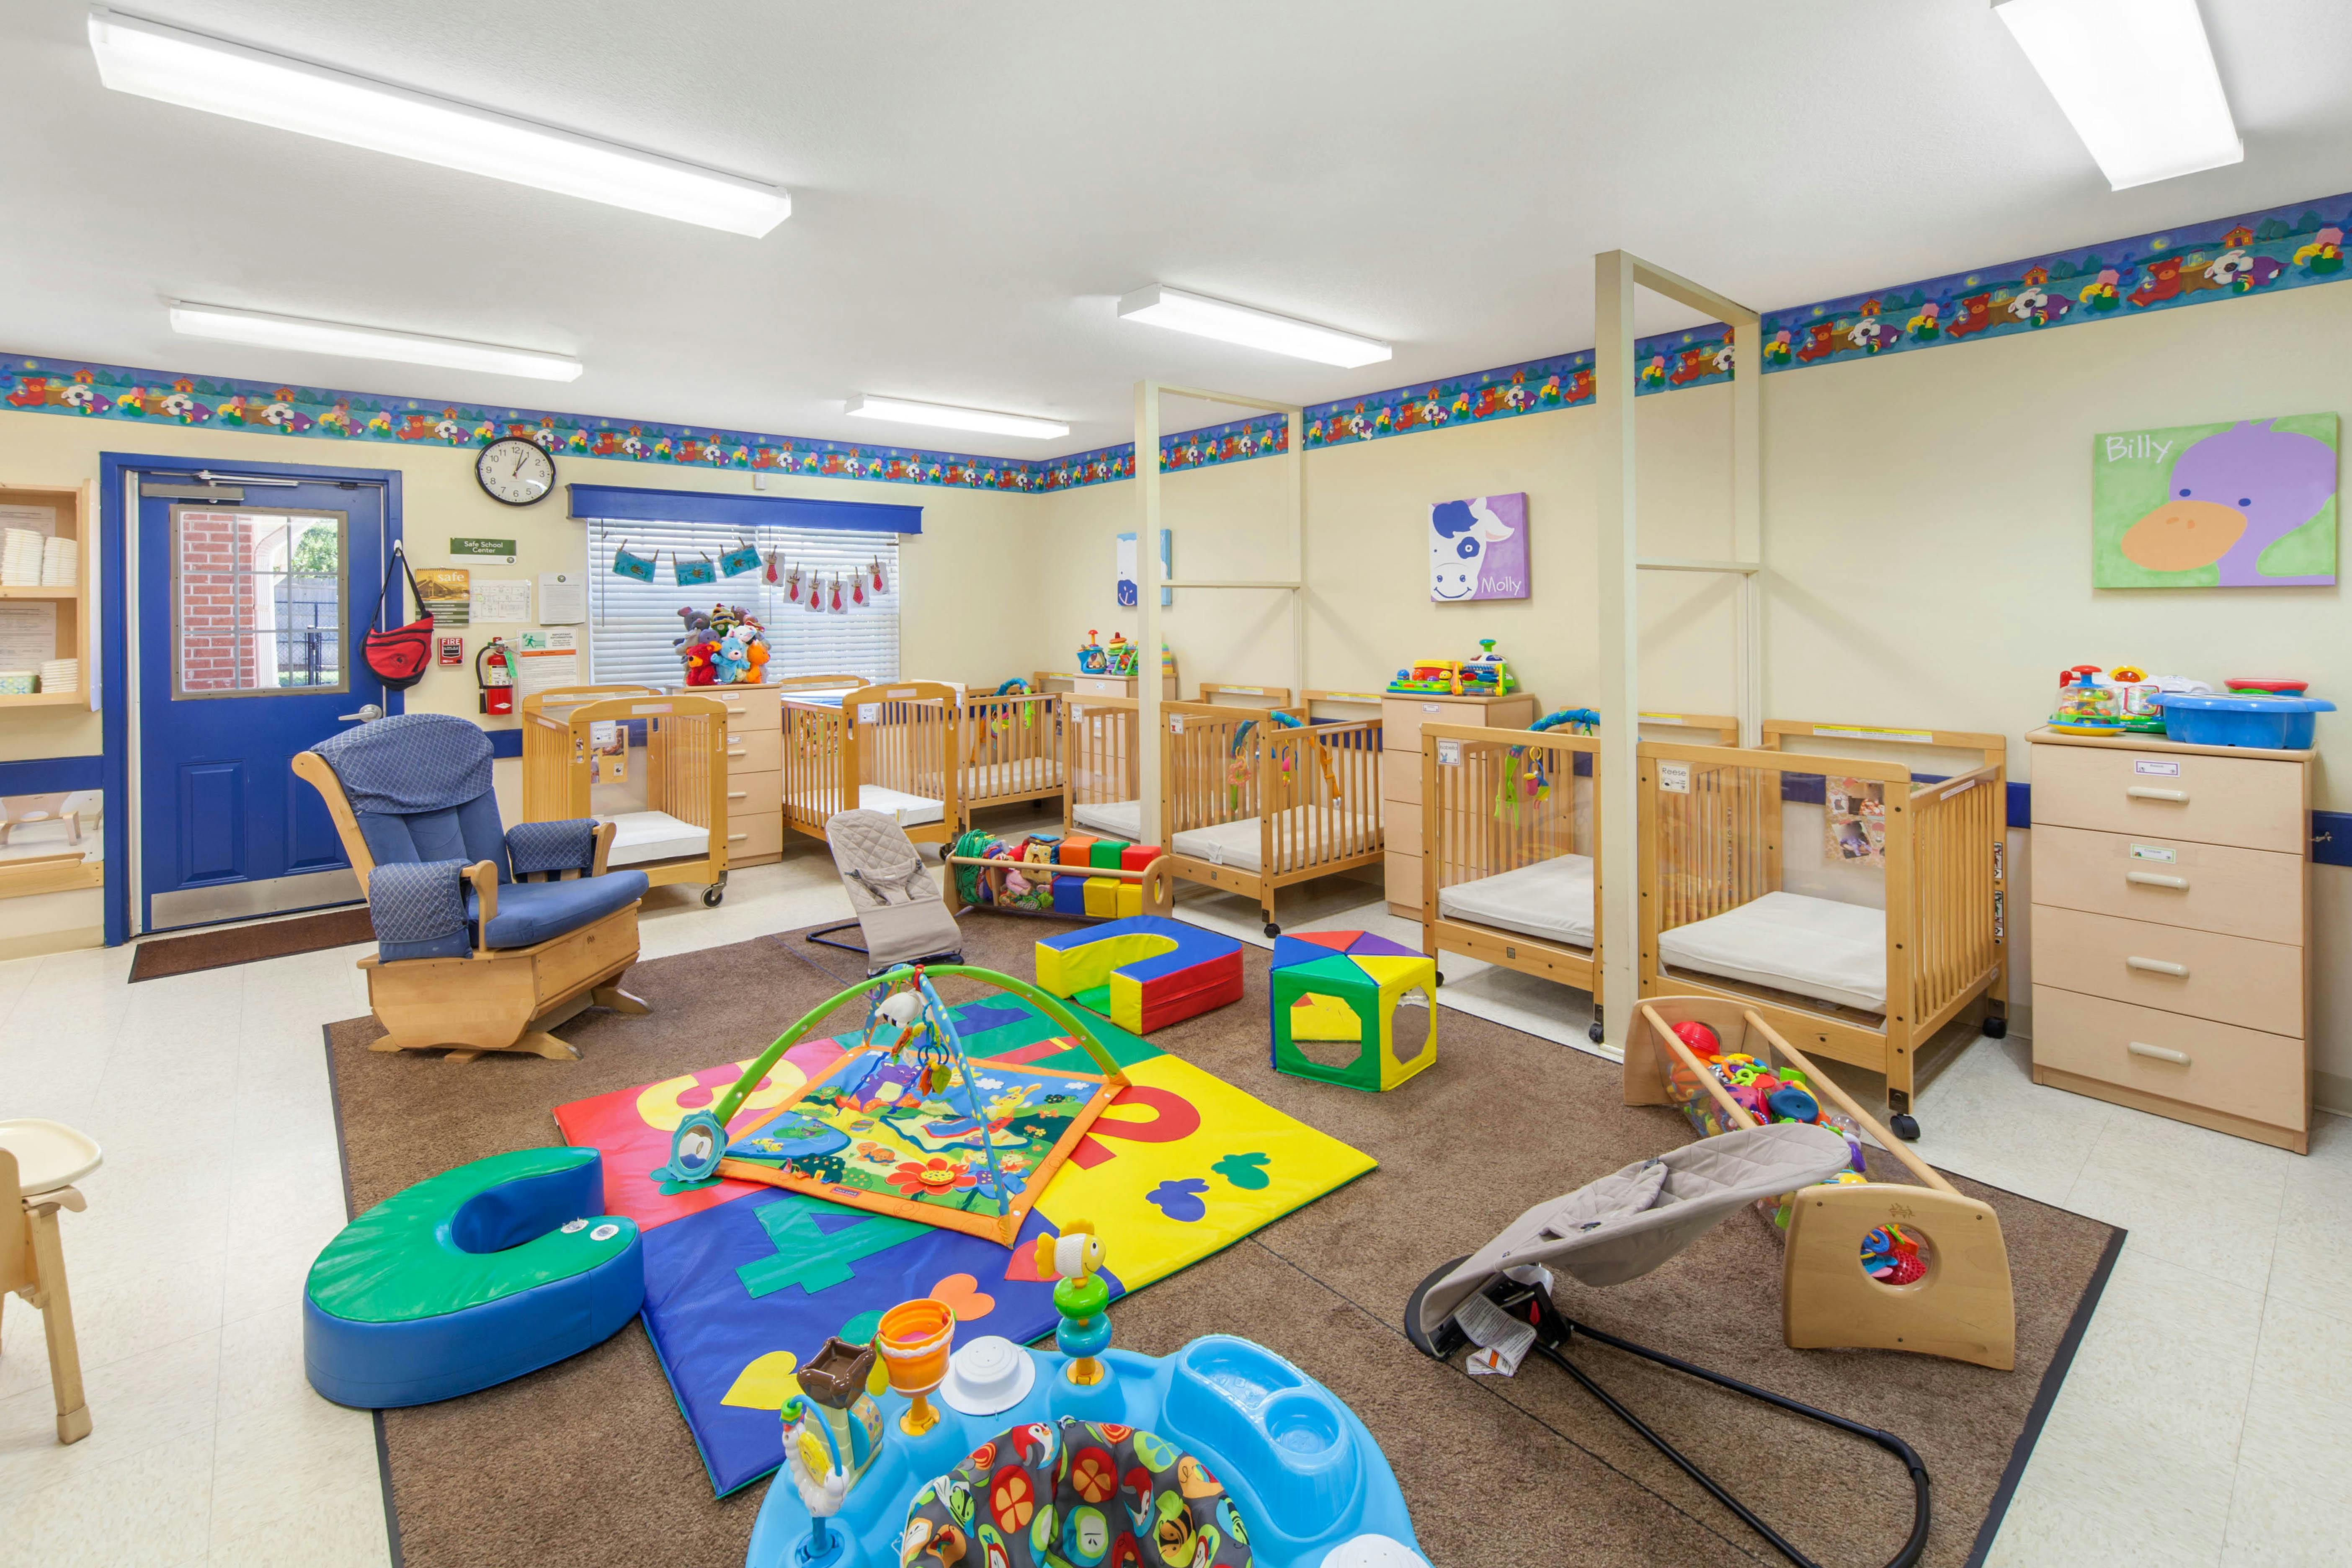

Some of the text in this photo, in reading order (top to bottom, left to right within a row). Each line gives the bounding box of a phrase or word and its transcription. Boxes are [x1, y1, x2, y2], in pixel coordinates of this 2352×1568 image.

[2105, 434, 2173, 464] Billy
[437, 572, 464, 582] safe
[1481, 576, 1522, 596] Molly
[1662, 767, 1687, 776] Reese
